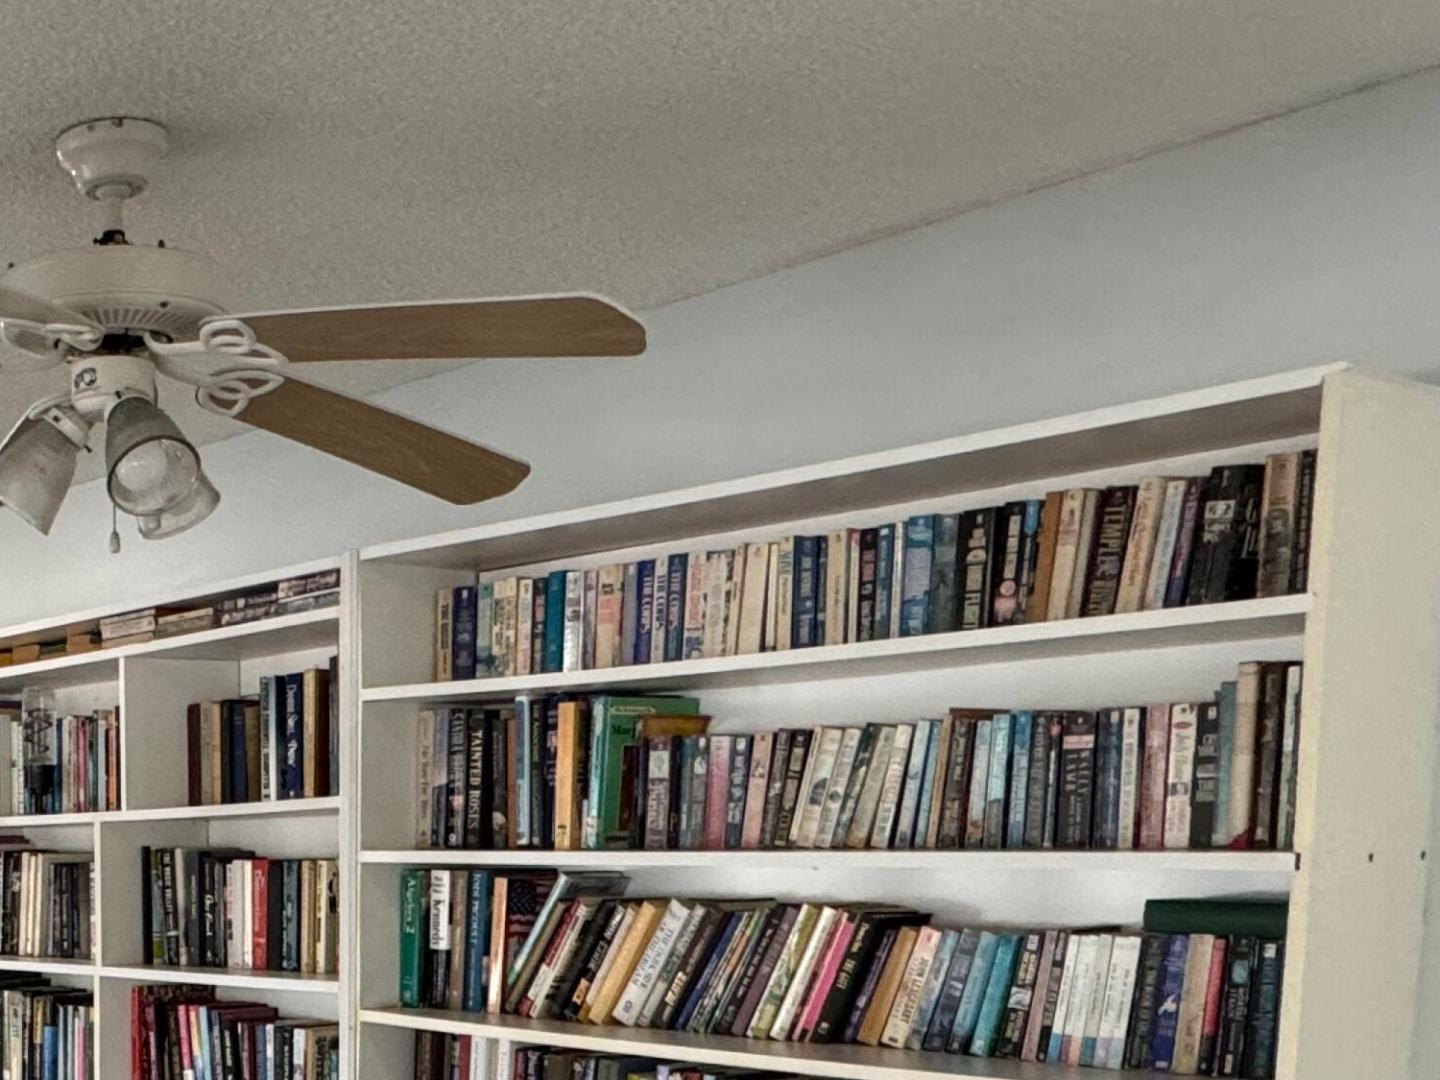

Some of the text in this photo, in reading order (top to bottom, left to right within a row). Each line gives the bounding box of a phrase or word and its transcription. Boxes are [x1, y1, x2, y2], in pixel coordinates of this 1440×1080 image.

[641, 576, 653, 634] THE CORPS
[655, 575, 666, 632] THE CORPS
[669, 594, 678, 631] CORPS
[468, 730, 483, 829] TAINTED ROSES
[405, 877, 417, 934] Algebra 2
[431, 899, 448, 946] Kennedy
